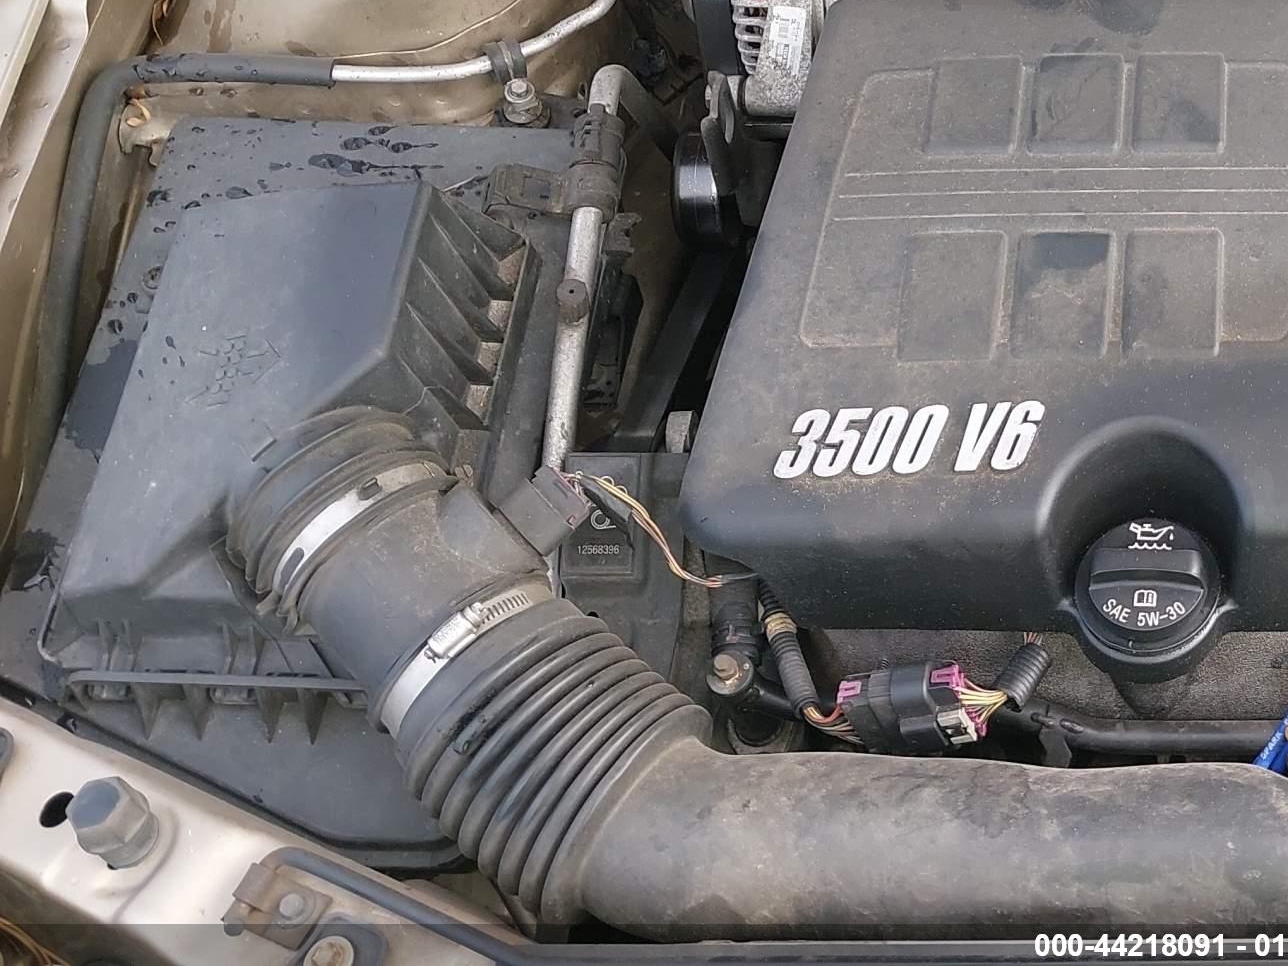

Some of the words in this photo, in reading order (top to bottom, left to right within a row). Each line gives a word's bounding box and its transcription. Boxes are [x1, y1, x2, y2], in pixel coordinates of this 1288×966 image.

[773, 404, 949, 479] 3500
[954, 400, 1046, 472] V6
[577, 545, 620, 554] 12568396
[1102, 598, 1131, 623] SAE
[1137, 602, 1186, 627] 5W-30
